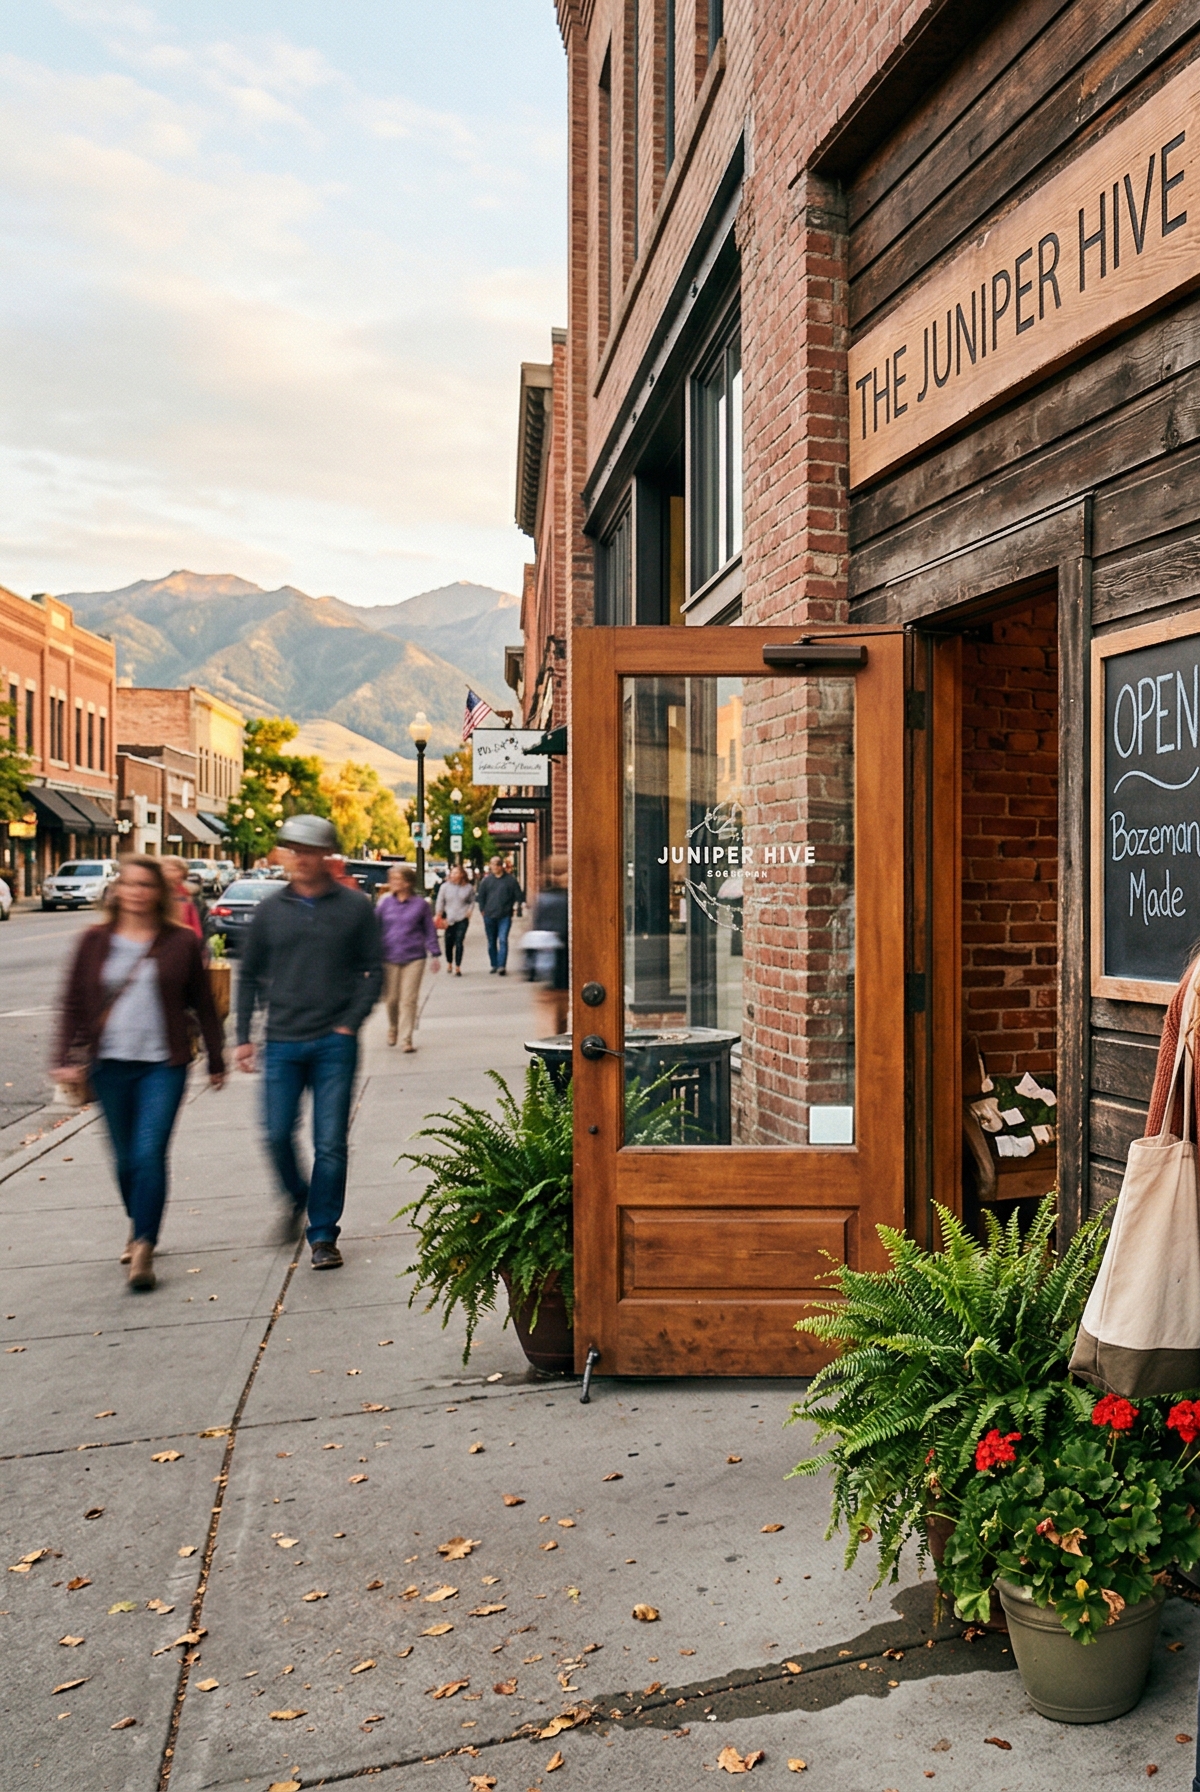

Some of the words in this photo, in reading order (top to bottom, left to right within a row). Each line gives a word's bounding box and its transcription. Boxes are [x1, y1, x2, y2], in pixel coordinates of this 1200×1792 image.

[855, 344, 908, 440] THE
[917, 232, 1062, 403] JUNIPER
[1078, 130, 1188, 293] HIVE
[1113, 664, 1199, 759] OPEN
[657, 846, 754, 865] JUNIPER
[764, 846, 816, 865] HIVE
[1130, 868, 1186, 926] Made
